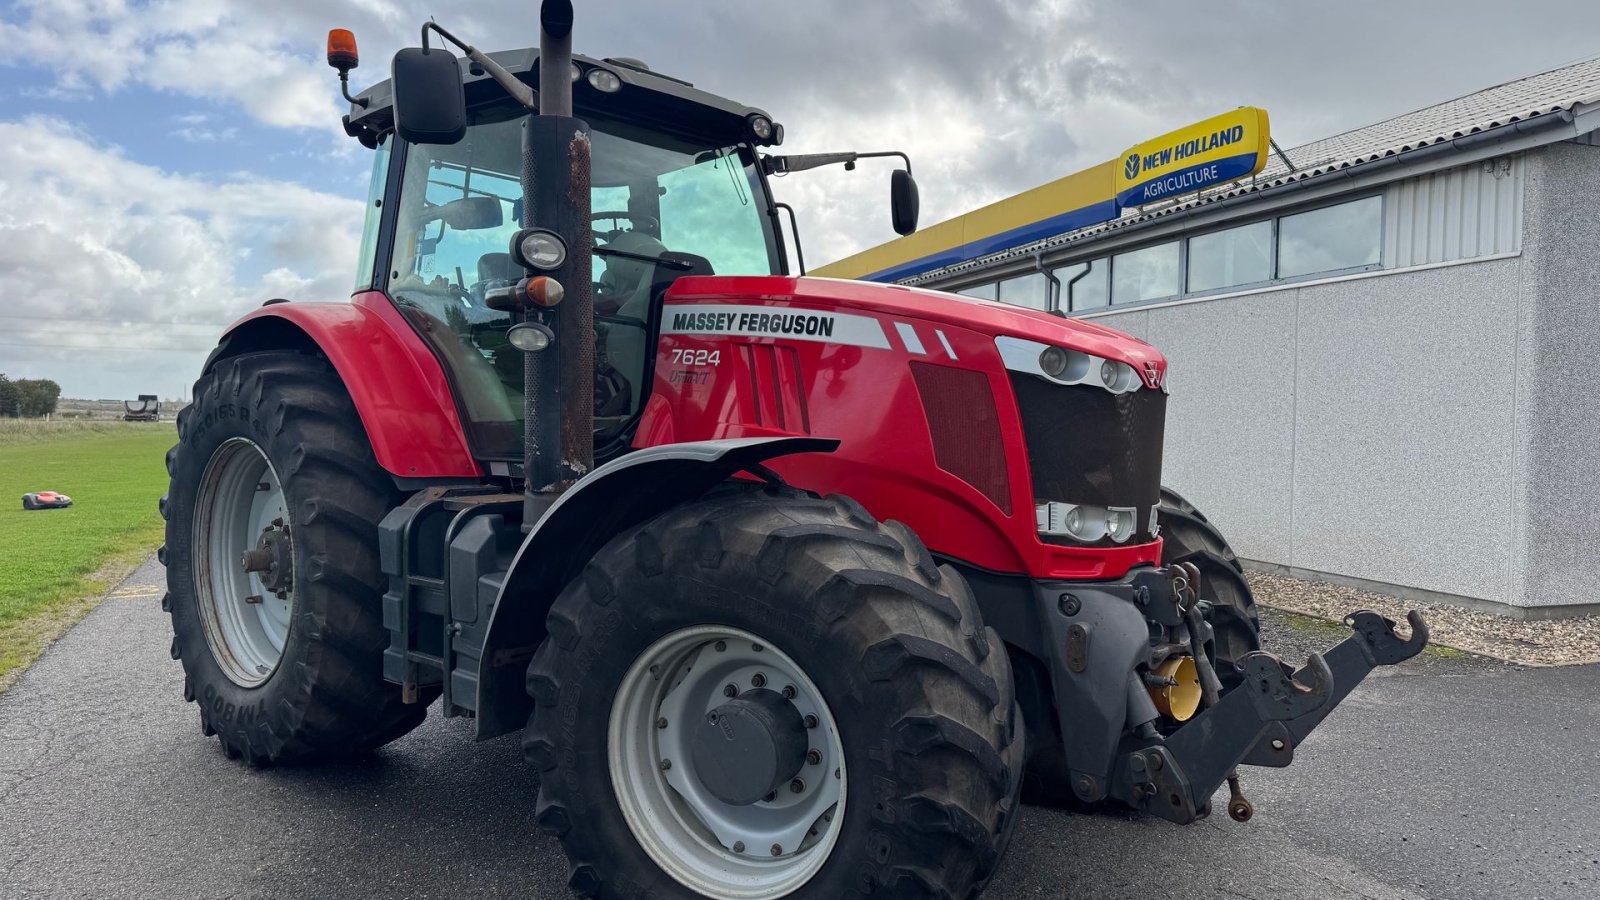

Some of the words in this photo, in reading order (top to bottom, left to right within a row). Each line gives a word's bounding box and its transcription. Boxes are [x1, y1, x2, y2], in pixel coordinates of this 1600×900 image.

[1142, 148, 1173, 171] NEW
[1174, 125, 1243, 161] HOLLAND
[1143, 165, 1218, 199] AGRICULTURE
[672, 313, 737, 331] MASSEY
[738, 313, 834, 337] FERGUSON
[671, 349, 720, 366] 7624
